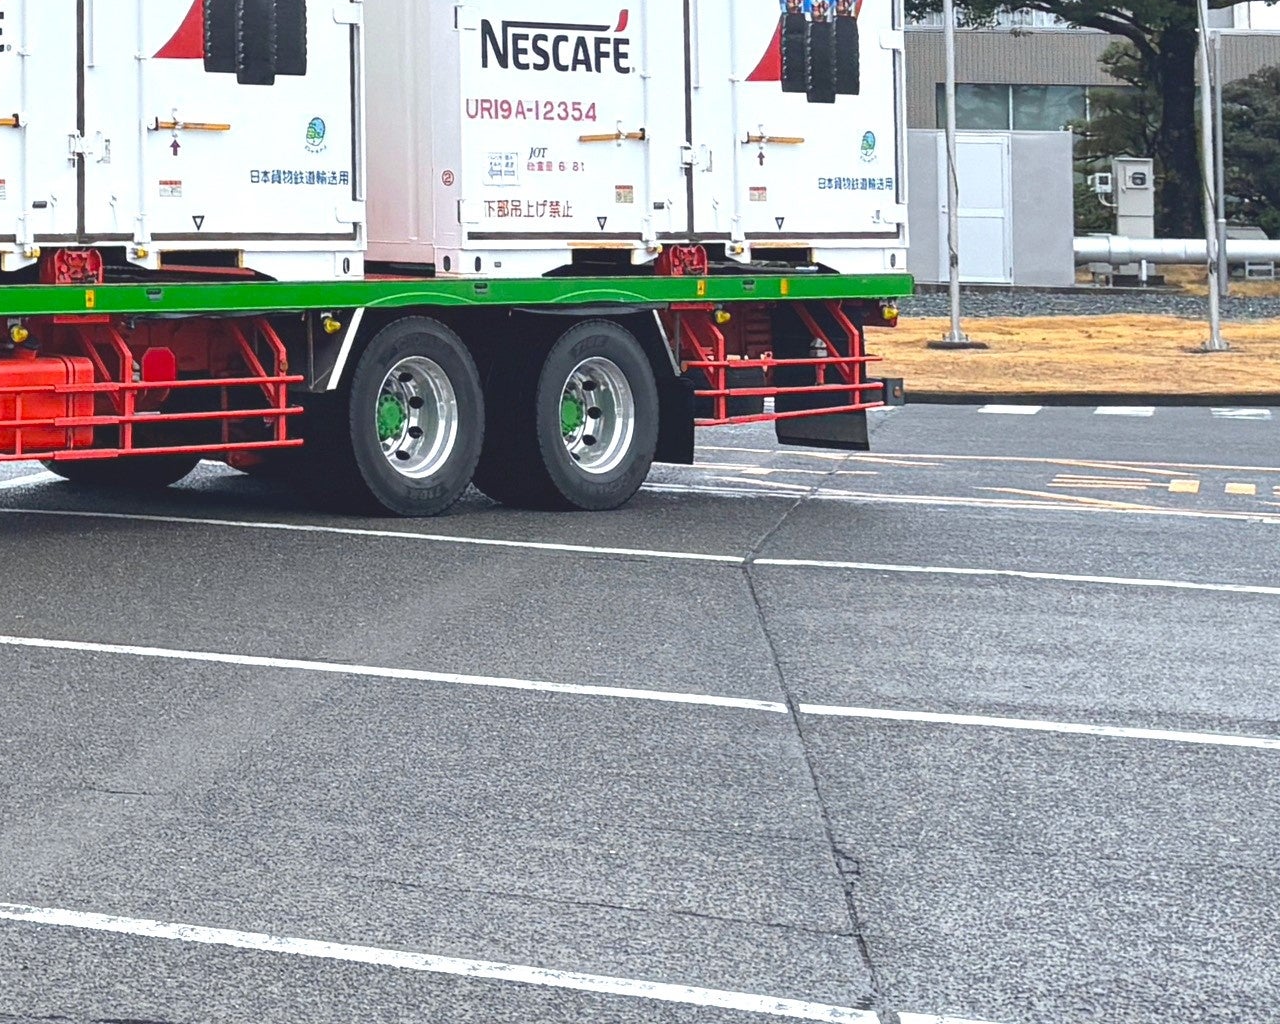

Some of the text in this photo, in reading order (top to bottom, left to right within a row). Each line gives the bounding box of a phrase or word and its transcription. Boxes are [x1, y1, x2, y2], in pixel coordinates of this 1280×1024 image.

[528, 147, 548, 160] JOT
[484, 199, 574, 218] 下部吊上げ禁止
